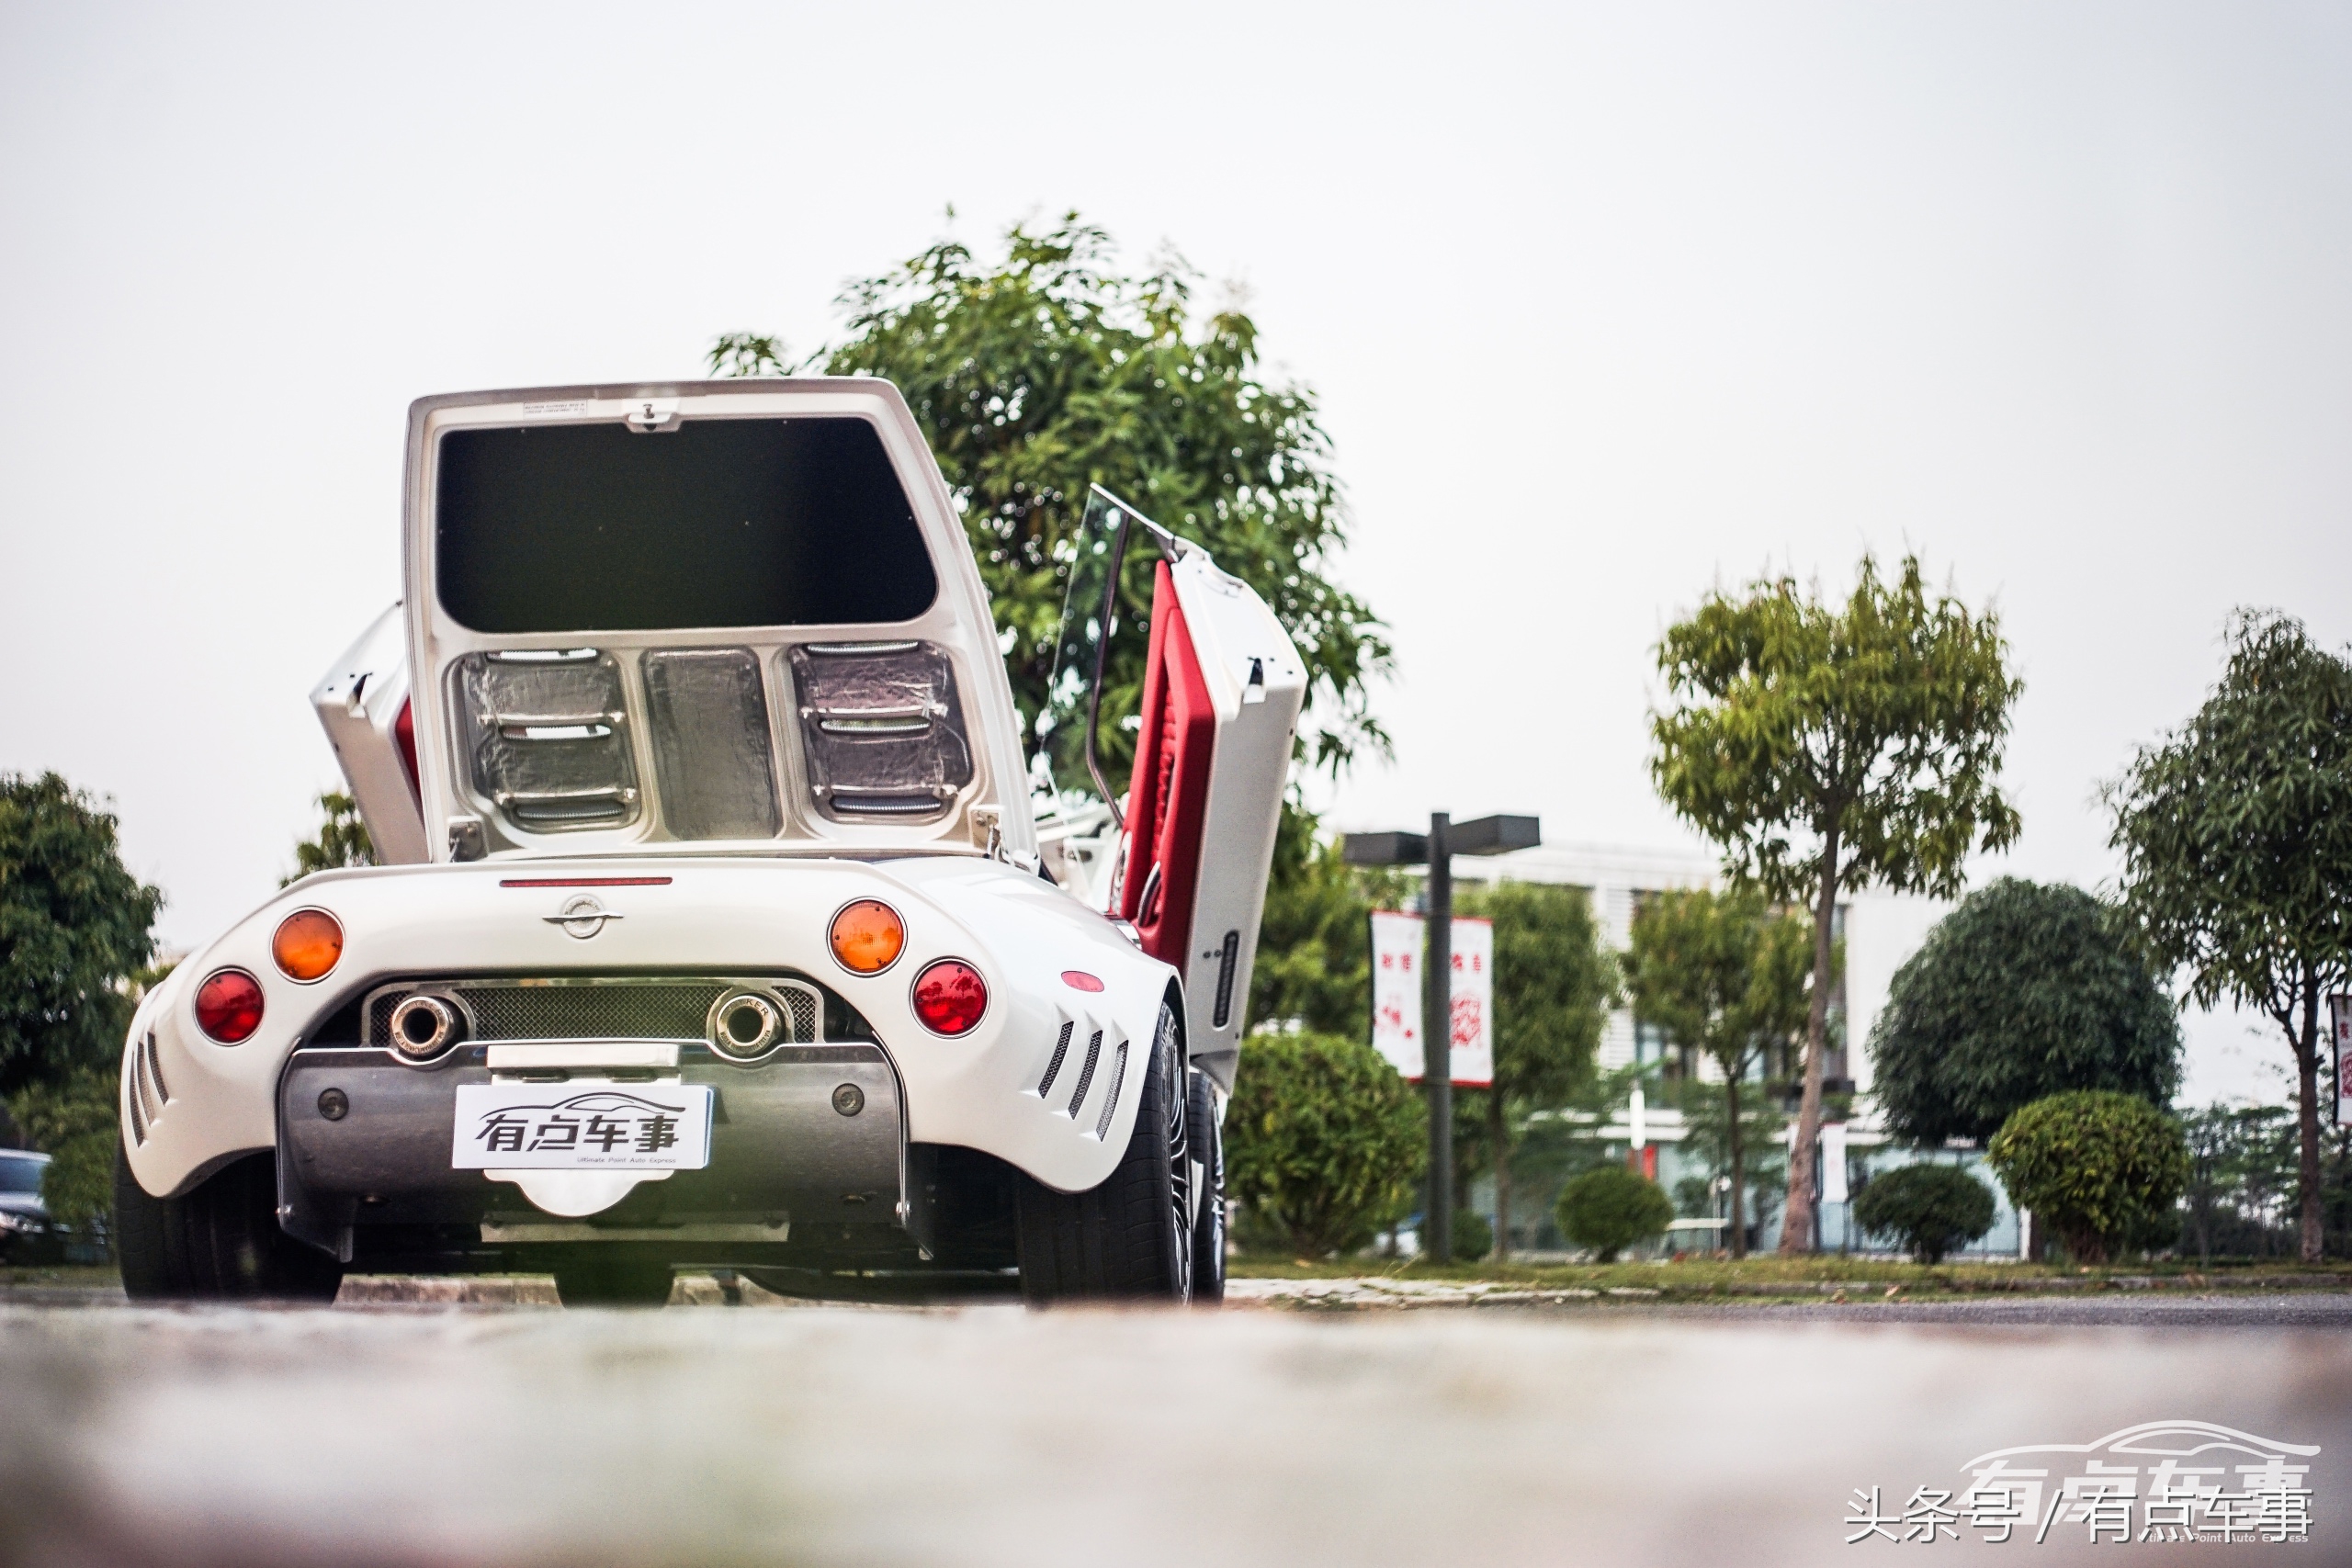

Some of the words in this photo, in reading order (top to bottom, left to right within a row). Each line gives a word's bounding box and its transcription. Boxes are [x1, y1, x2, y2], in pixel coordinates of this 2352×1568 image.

[474, 1113, 680, 1153] 有点车事
[650, 1156, 676, 1165] Express
